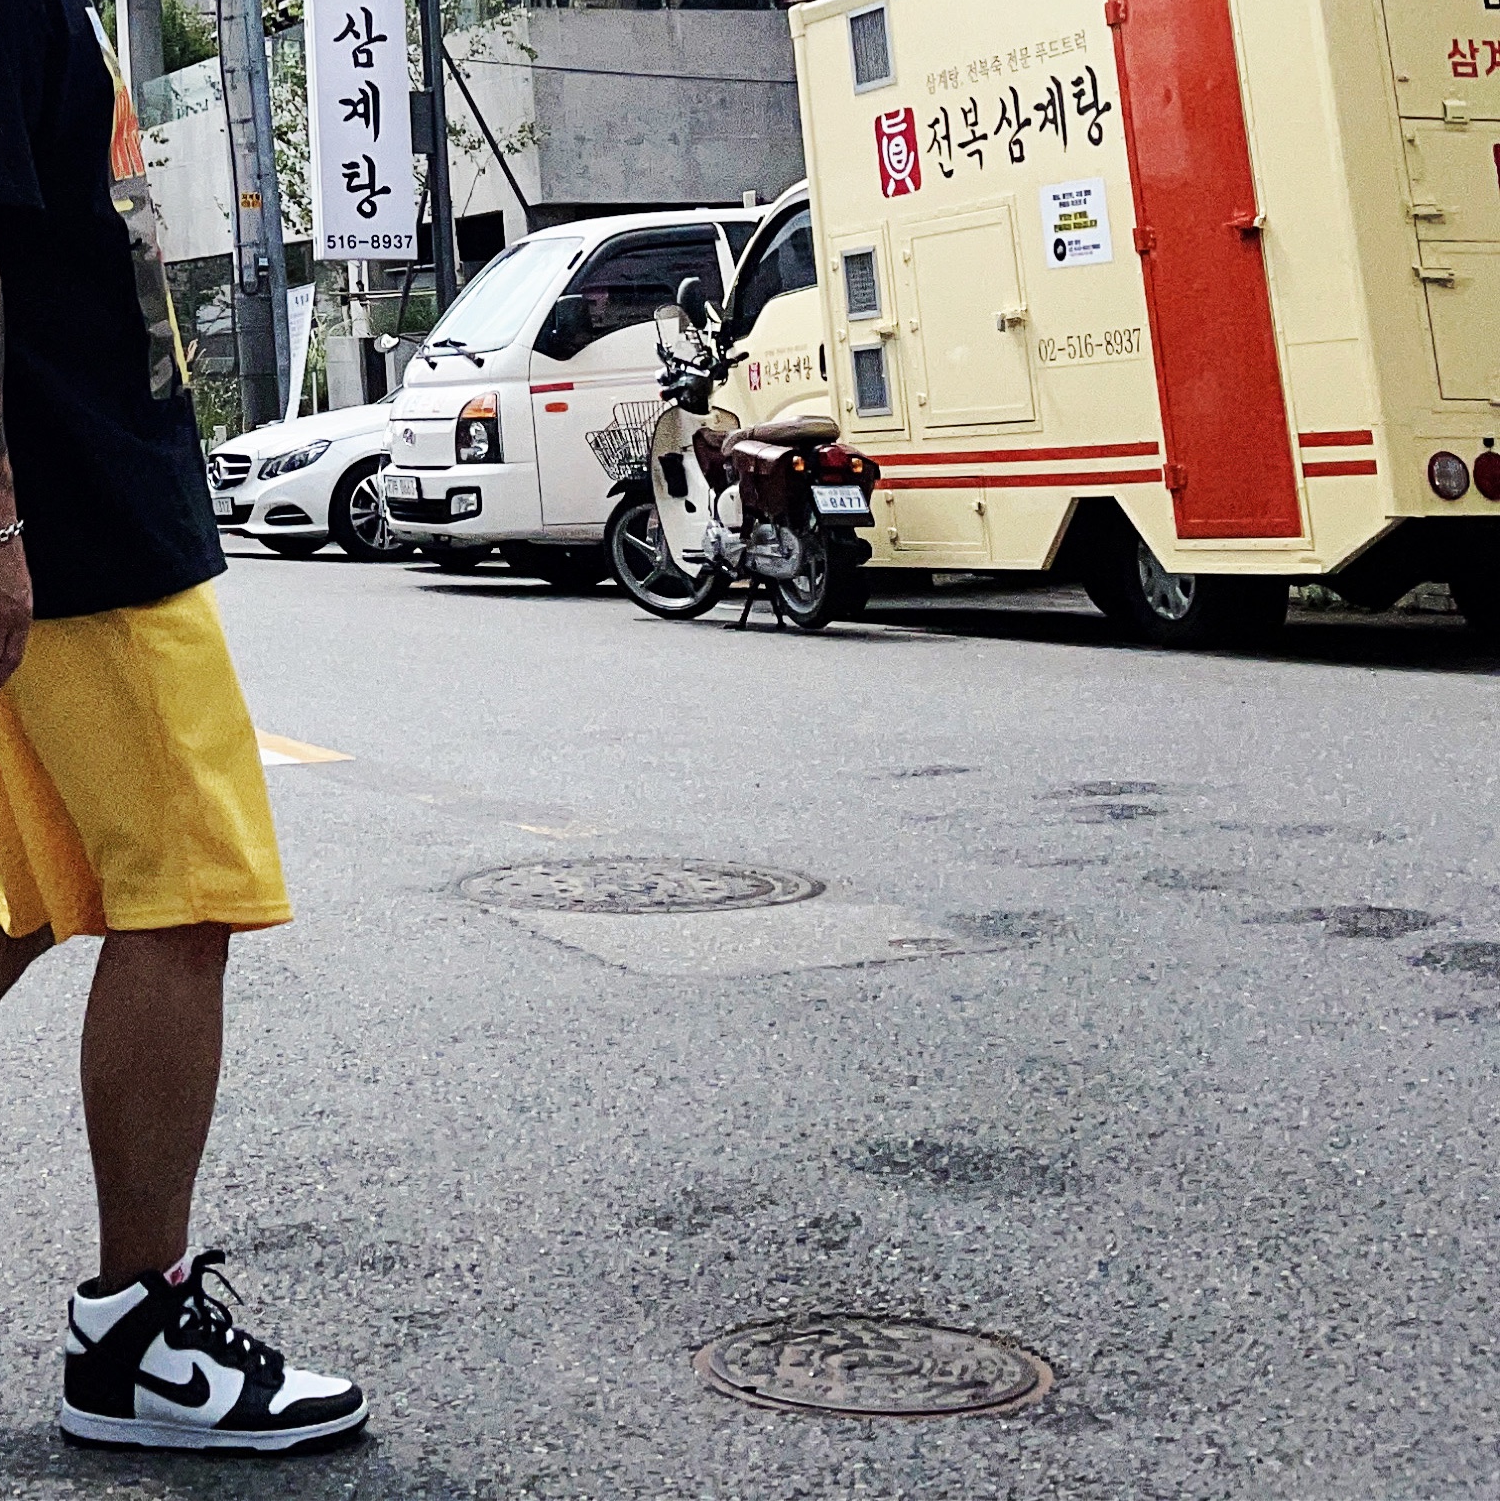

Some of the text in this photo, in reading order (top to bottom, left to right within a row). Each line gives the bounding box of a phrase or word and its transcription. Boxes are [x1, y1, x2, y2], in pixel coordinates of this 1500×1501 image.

[1035, 29, 1087, 64] 푸드트럭
[926, 65, 1112, 179] 전복삼계탕
[327, 234, 413, 250] 516-8937
[1038, 328, 1141, 362] 02-516-8937
